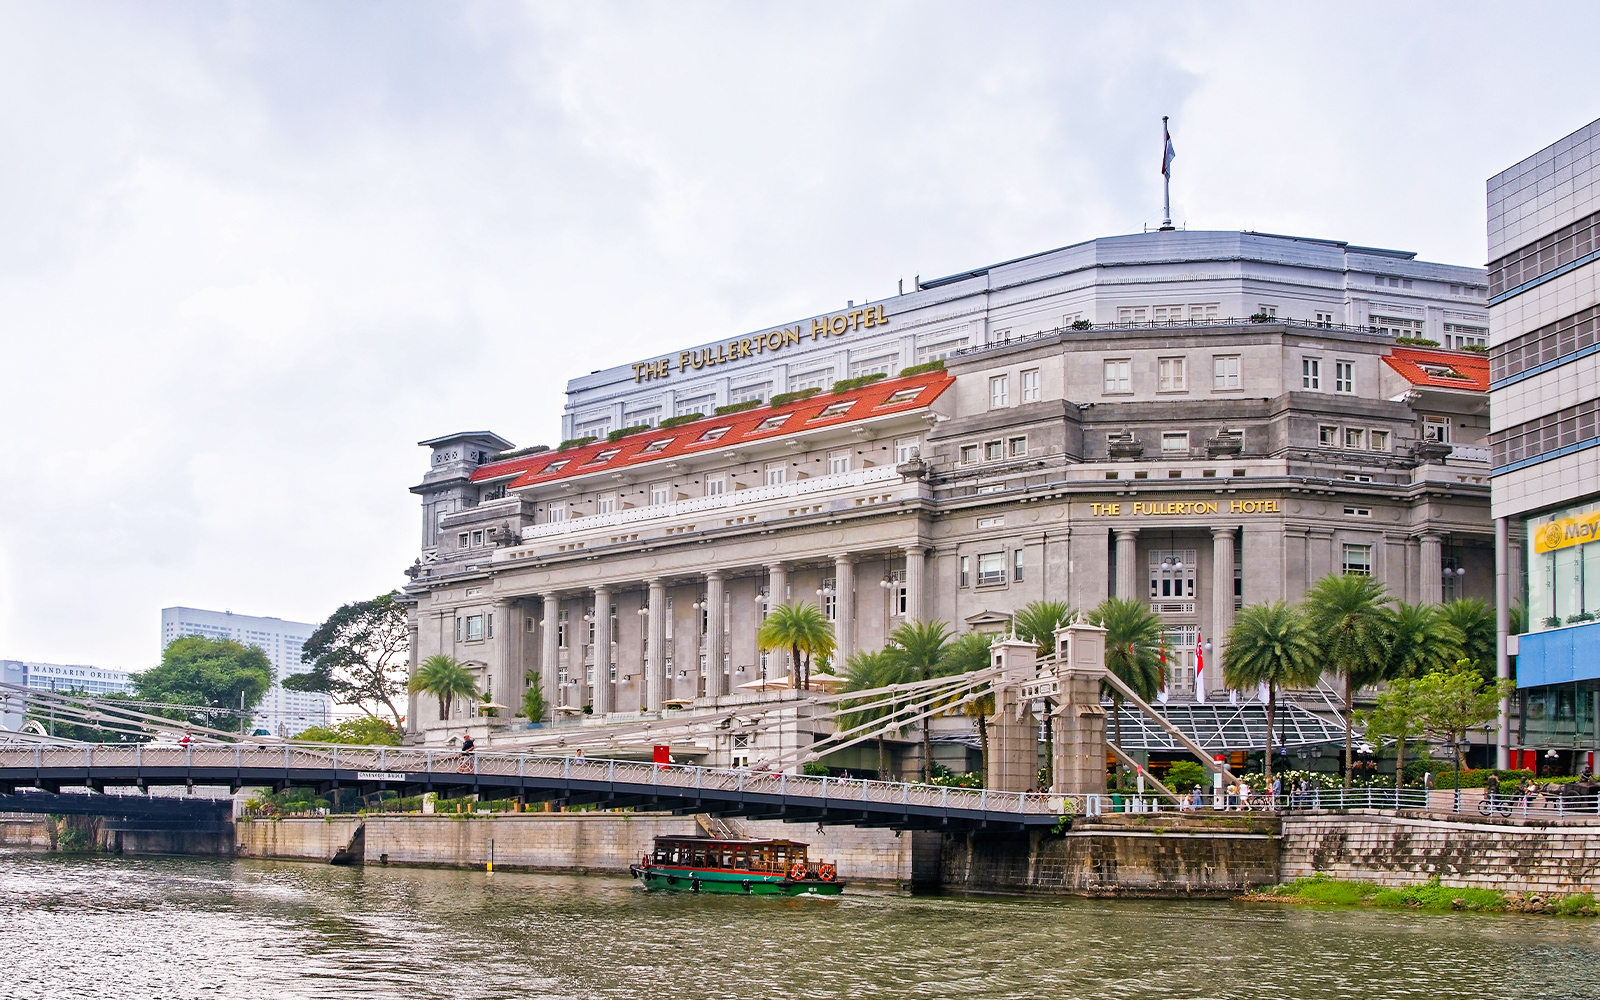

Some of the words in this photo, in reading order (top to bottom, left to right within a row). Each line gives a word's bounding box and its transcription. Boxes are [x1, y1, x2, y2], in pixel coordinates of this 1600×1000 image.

[632, 358, 669, 384] THE
[678, 325, 801, 373] FULLERTON
[811, 304, 888, 341] HOTEL
[1090, 502, 1120, 516] THE
[1132, 502, 1218, 516] FULLERTON
[1230, 500, 1281, 514] HOTEL
[1565, 521, 1600, 540] May
[33, 665, 85, 677] MANDARIN
[90, 671, 127, 681] ORIENT
